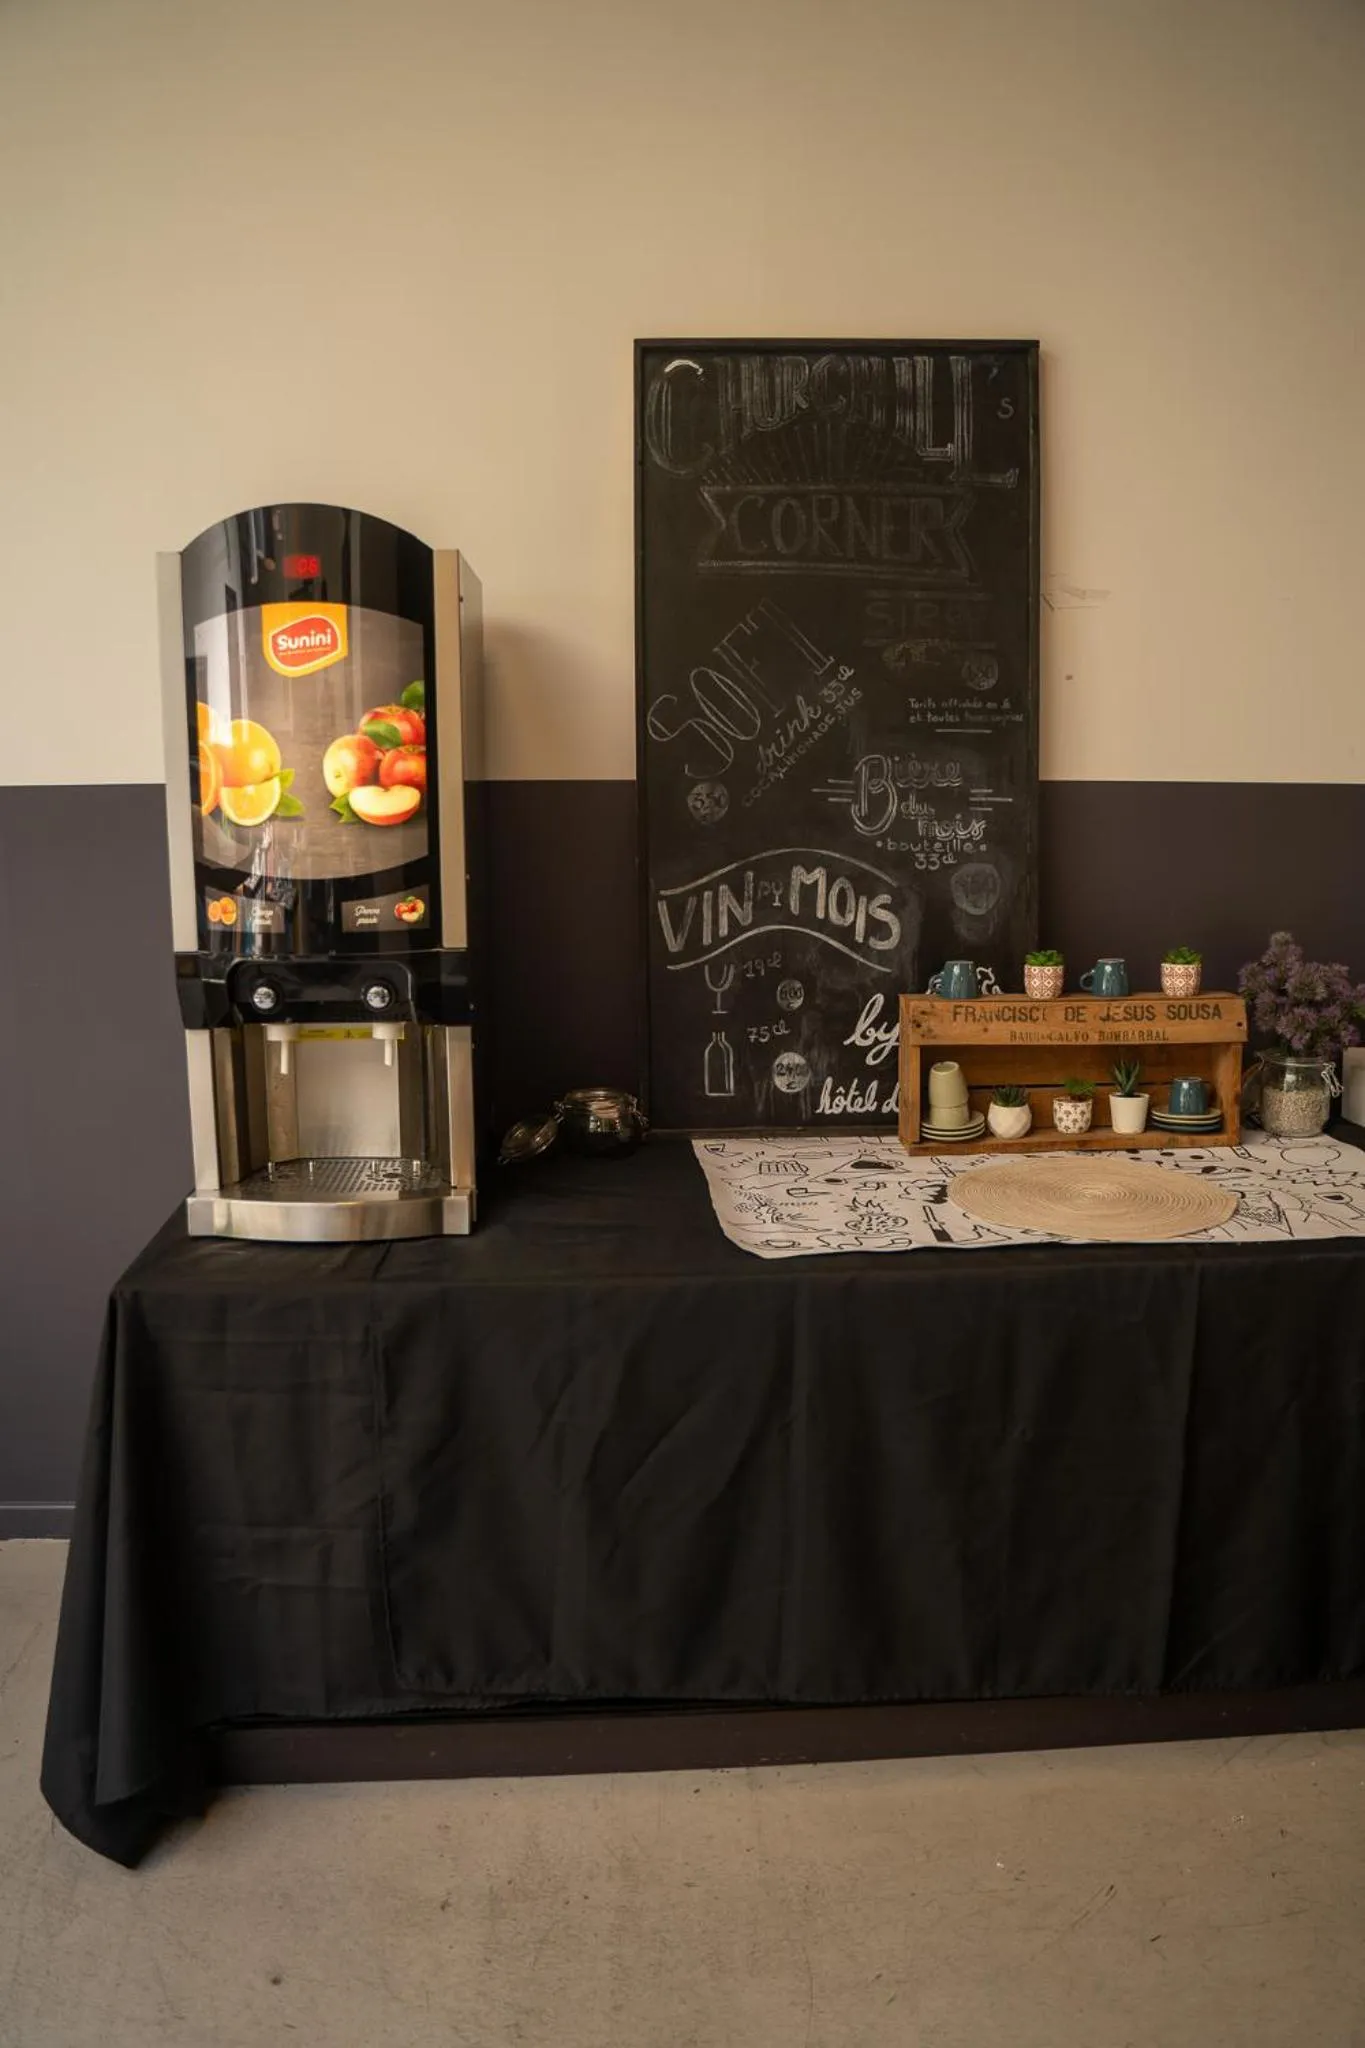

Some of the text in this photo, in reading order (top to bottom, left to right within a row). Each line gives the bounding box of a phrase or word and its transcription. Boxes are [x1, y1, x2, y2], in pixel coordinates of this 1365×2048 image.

[732, 495, 944, 564] CORNER
[277, 628, 332, 651] Sunini
[647, 598, 836, 779] SOFT
[656, 870, 754, 953] VIN
[789, 864, 901, 951] MOIS
[843, 992, 900, 1066] by
[1064, 1005, 1087, 1022] DE
[1098, 1003, 1156, 1022] JESUS
[1166, 1002, 1222, 1020] SOUSA
[815, 1074, 888, 1115] hôtel
